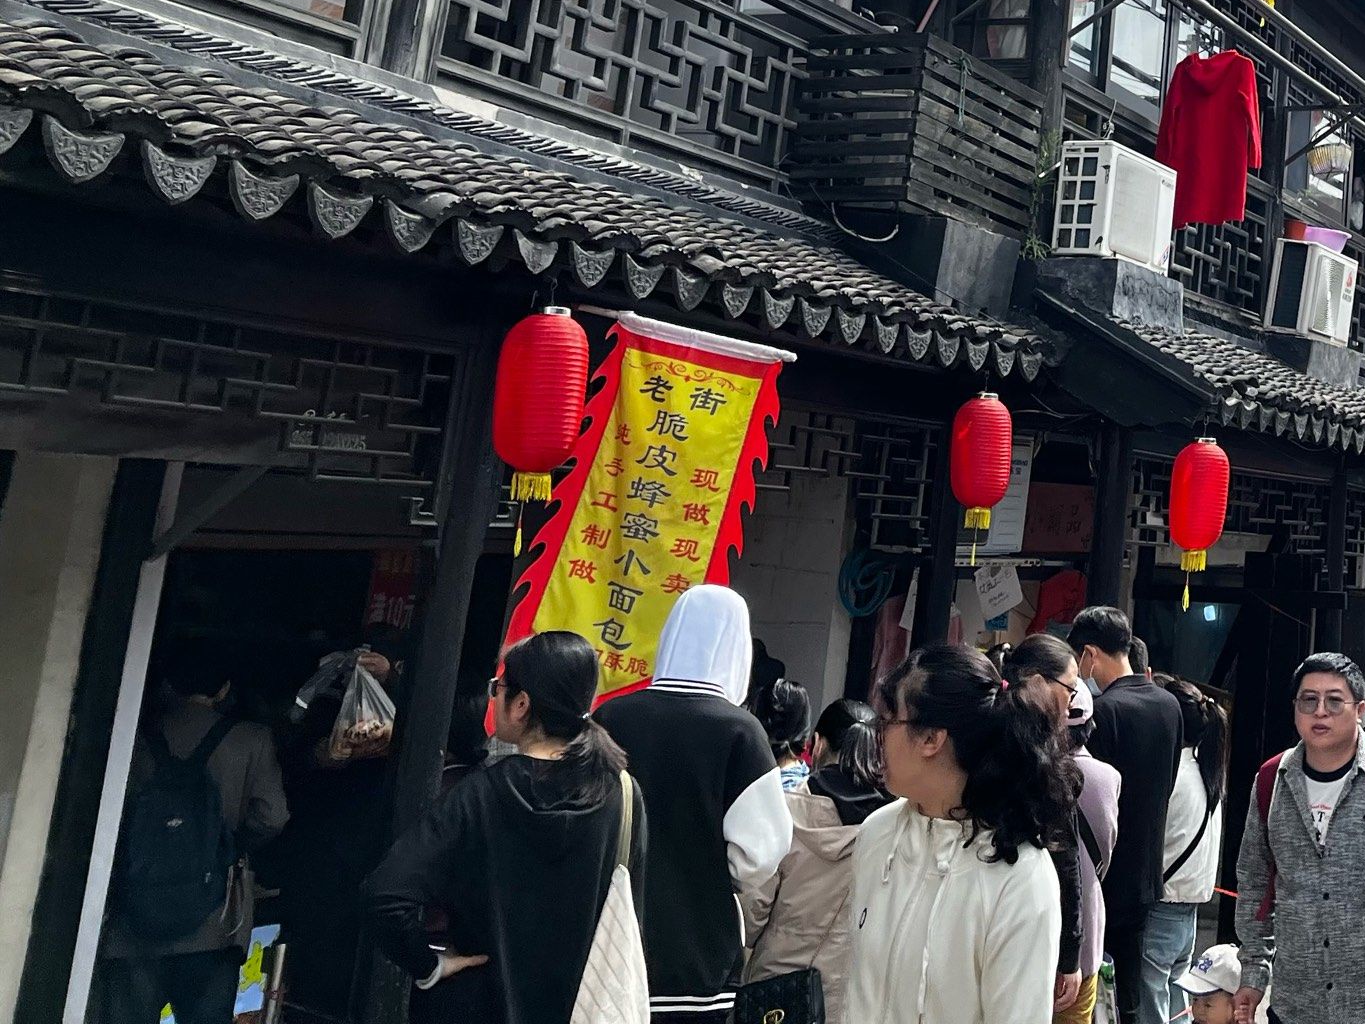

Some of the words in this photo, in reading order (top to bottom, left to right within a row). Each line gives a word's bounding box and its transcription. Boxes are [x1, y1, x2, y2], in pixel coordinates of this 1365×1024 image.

[568, 423, 631, 585] 纯手工制做
[661, 468, 720, 595] 现做现卖
[595, 649, 648, 677] 酥脆
